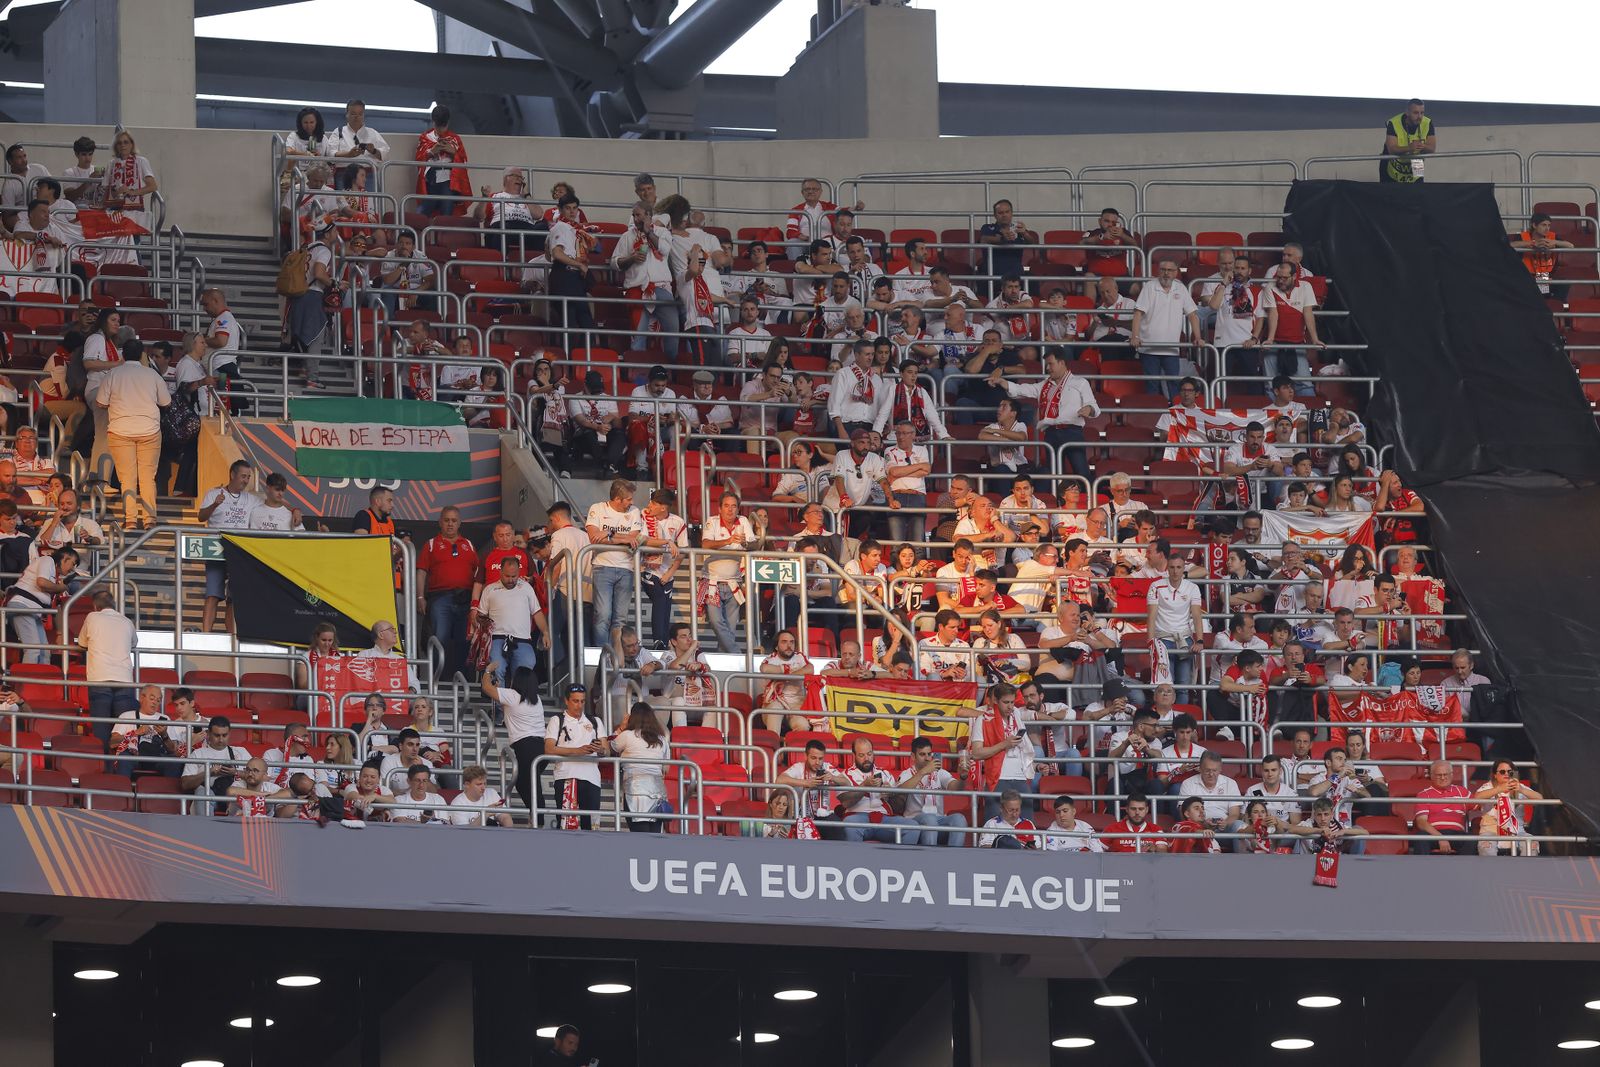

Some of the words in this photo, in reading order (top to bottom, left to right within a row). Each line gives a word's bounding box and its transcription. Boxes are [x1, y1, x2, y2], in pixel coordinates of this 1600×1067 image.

[301, 426, 341, 446] LORA
[350, 427, 373, 446] DE
[382, 427, 452, 446] ESTEPA
[846, 700, 946, 732] DYC
[629, 858, 748, 897] UEFA
[760, 863, 935, 905] EUROPA
[947, 871, 1121, 913] LEAGUE
